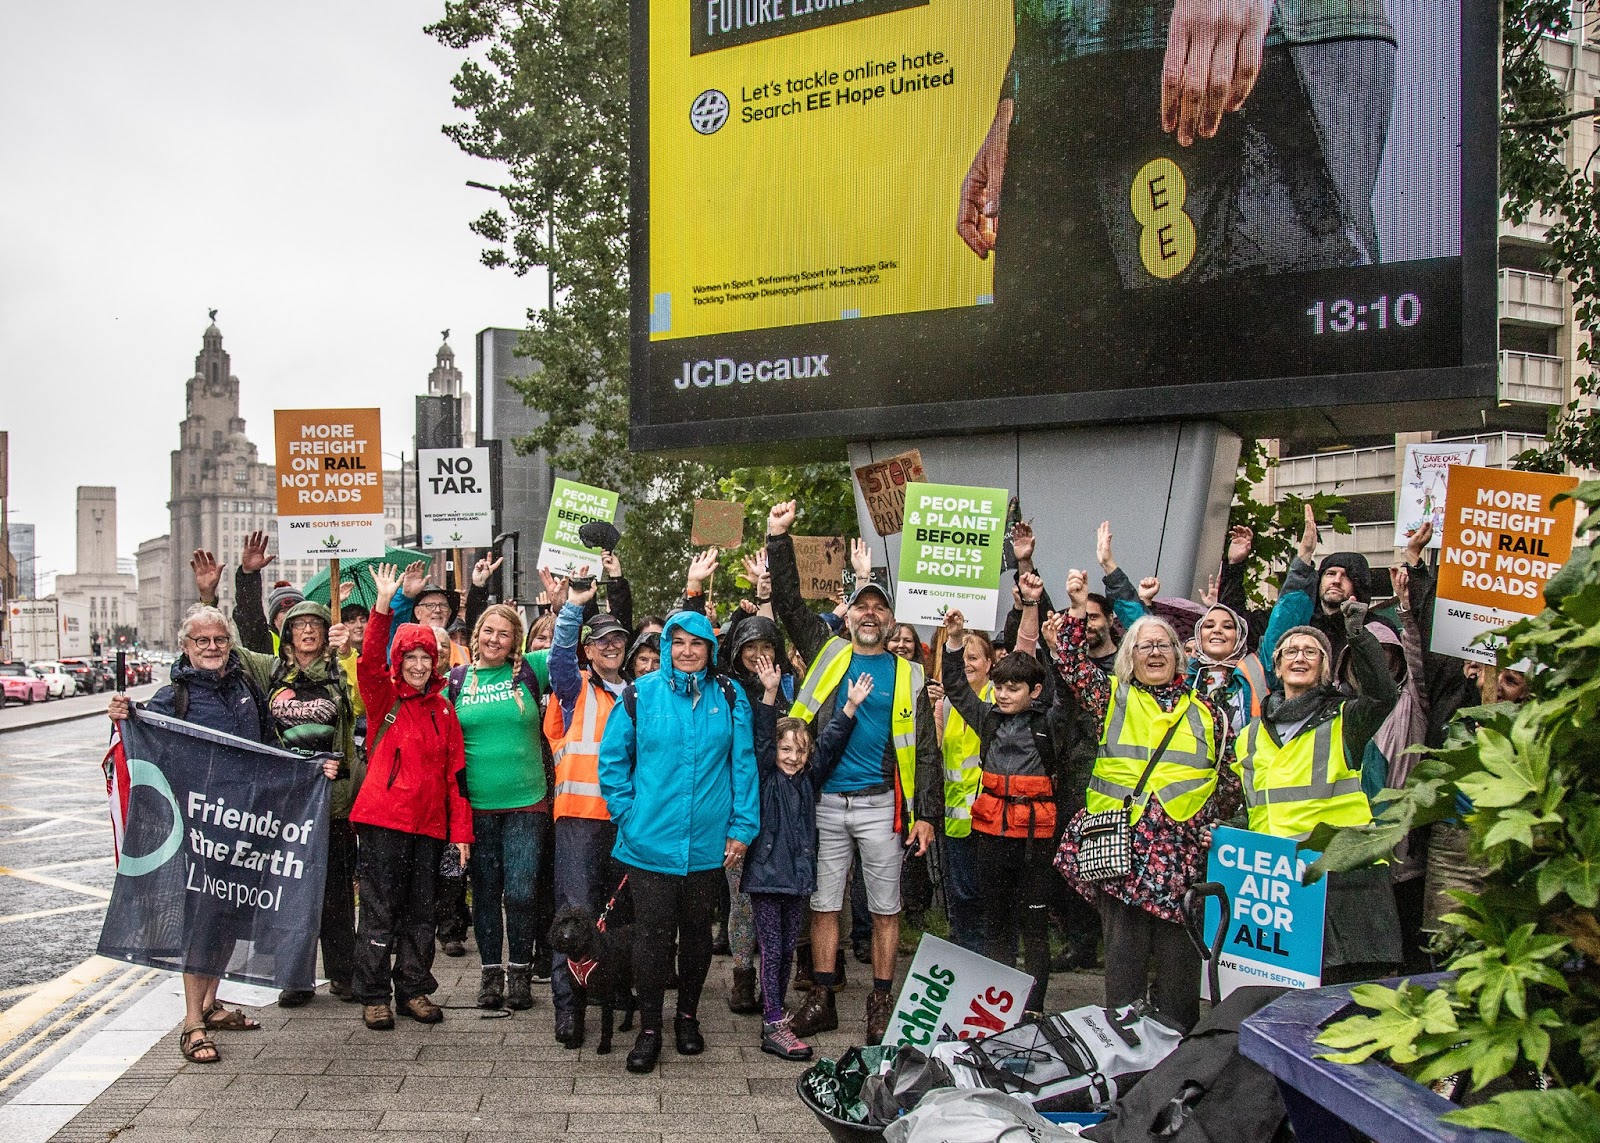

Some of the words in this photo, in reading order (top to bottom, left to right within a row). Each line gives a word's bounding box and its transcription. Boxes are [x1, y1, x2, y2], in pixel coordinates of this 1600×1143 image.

[707, 0, 785, 35] FUTURE
[742, 81, 782, 102] Let's
[786, 70, 838, 93] tackle
[844, 59, 897, 80] online
[902, 50, 949, 70] hate.
[741, 99, 801, 123] Search
[807, 91, 831, 111] EE
[835, 84, 885, 106] Hope
[891, 67, 954, 95] United
[839, 264, 876, 274] Teenage
[1306, 293, 1422, 334] 13:10
[674, 354, 830, 390] JCDecaux
[301, 424, 354, 439] MORE
[289, 440, 367, 455] FREIGHT
[1442, 453, 1461, 462] OUR
[292, 457, 318, 471] ON
[324, 456, 366, 470] RAIL
[437, 457, 473, 475] NO
[281, 474, 319, 488] NOT
[325, 472, 378, 486] MORE
[428, 476, 482, 494] TAR.
[865, 457, 912, 493] STOP
[298, 489, 362, 504] ROADS
[562, 488, 609, 507] PEOPLE
[869, 489, 906, 512] PAVIN
[919, 495, 993, 514] PEOPLE
[1476, 488, 1542, 512] MORE
[554, 497, 563, 507] &
[565, 499, 612, 519] PLANET
[558, 509, 604, 524] BEFO
[908, 511, 921, 525] &
[926, 512, 1000, 532] PLANET
[1459, 507, 1556, 536] FREIGHT
[916, 528, 990, 547] BEFORE
[1460, 529, 1493, 549] ON
[1499, 534, 1550, 558] RAIL
[562, 550, 579, 558] SOUTH
[920, 545, 982, 563] PEEL'S
[1445, 547, 1494, 570] NOT
[1496, 555, 1562, 580] MORE
[916, 561, 984, 579] PROFIT
[1461, 570, 1539, 599] ROADS
[929, 590, 955, 598] SOUTH
[956, 592, 987, 601] SEFTON
[1447, 608, 1471, 620] SAVE
[1472, 613, 1504, 626] SOUTH
[1461, 646, 1476, 654] SAVE
[272, 707, 318, 718] PLANET
[188, 791, 281, 839] Friends
[282, 819, 314, 845] of
[189, 827, 230, 861] the
[230, 840, 304, 880] Earth
[1238, 874, 1290, 906] AIR
[1233, 897, 1294, 932] FOR
[1233, 924, 1289, 957] ALL
[1238, 964, 1268, 978] SOUTH
[1270, 973, 1306, 988] SEFTON
